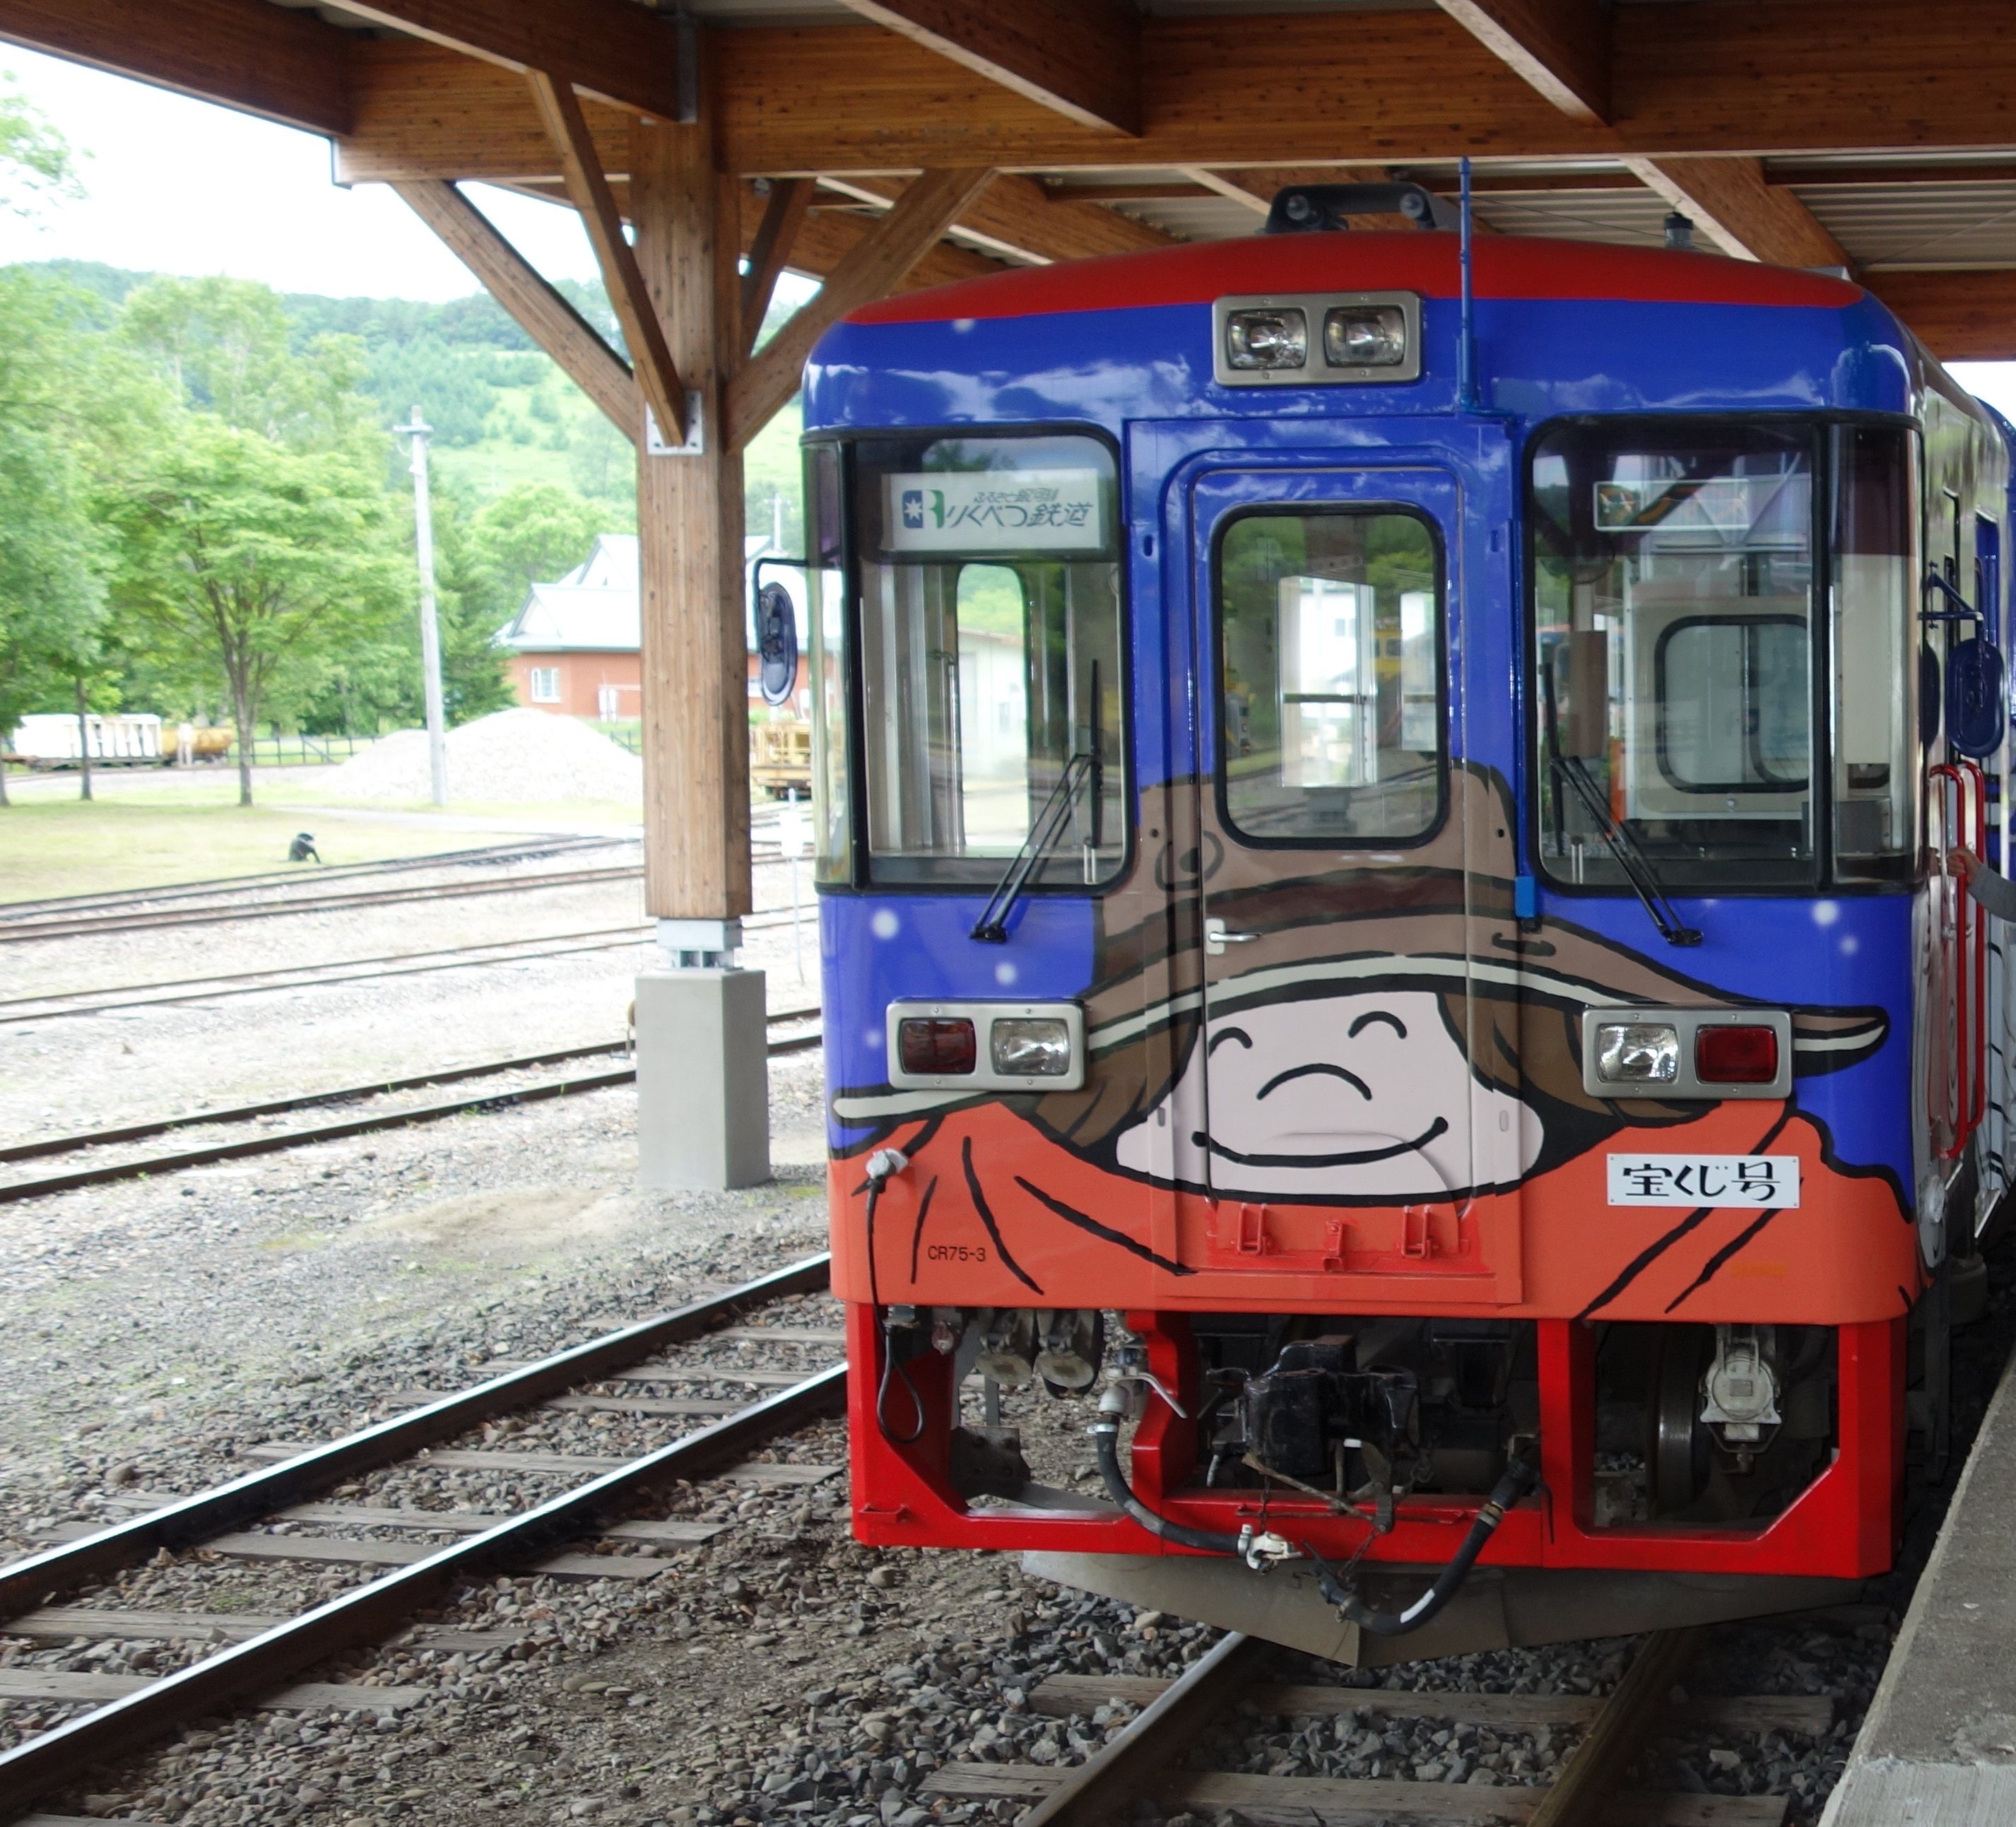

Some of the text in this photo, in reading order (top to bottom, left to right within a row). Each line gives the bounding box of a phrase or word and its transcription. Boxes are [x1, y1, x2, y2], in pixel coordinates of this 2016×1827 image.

[945, 502, 1093, 529] りくべつ鉄道
[1622, 1161, 1781, 1202] 宝くじ号
[927, 1245, 986, 1262] CR75-3
